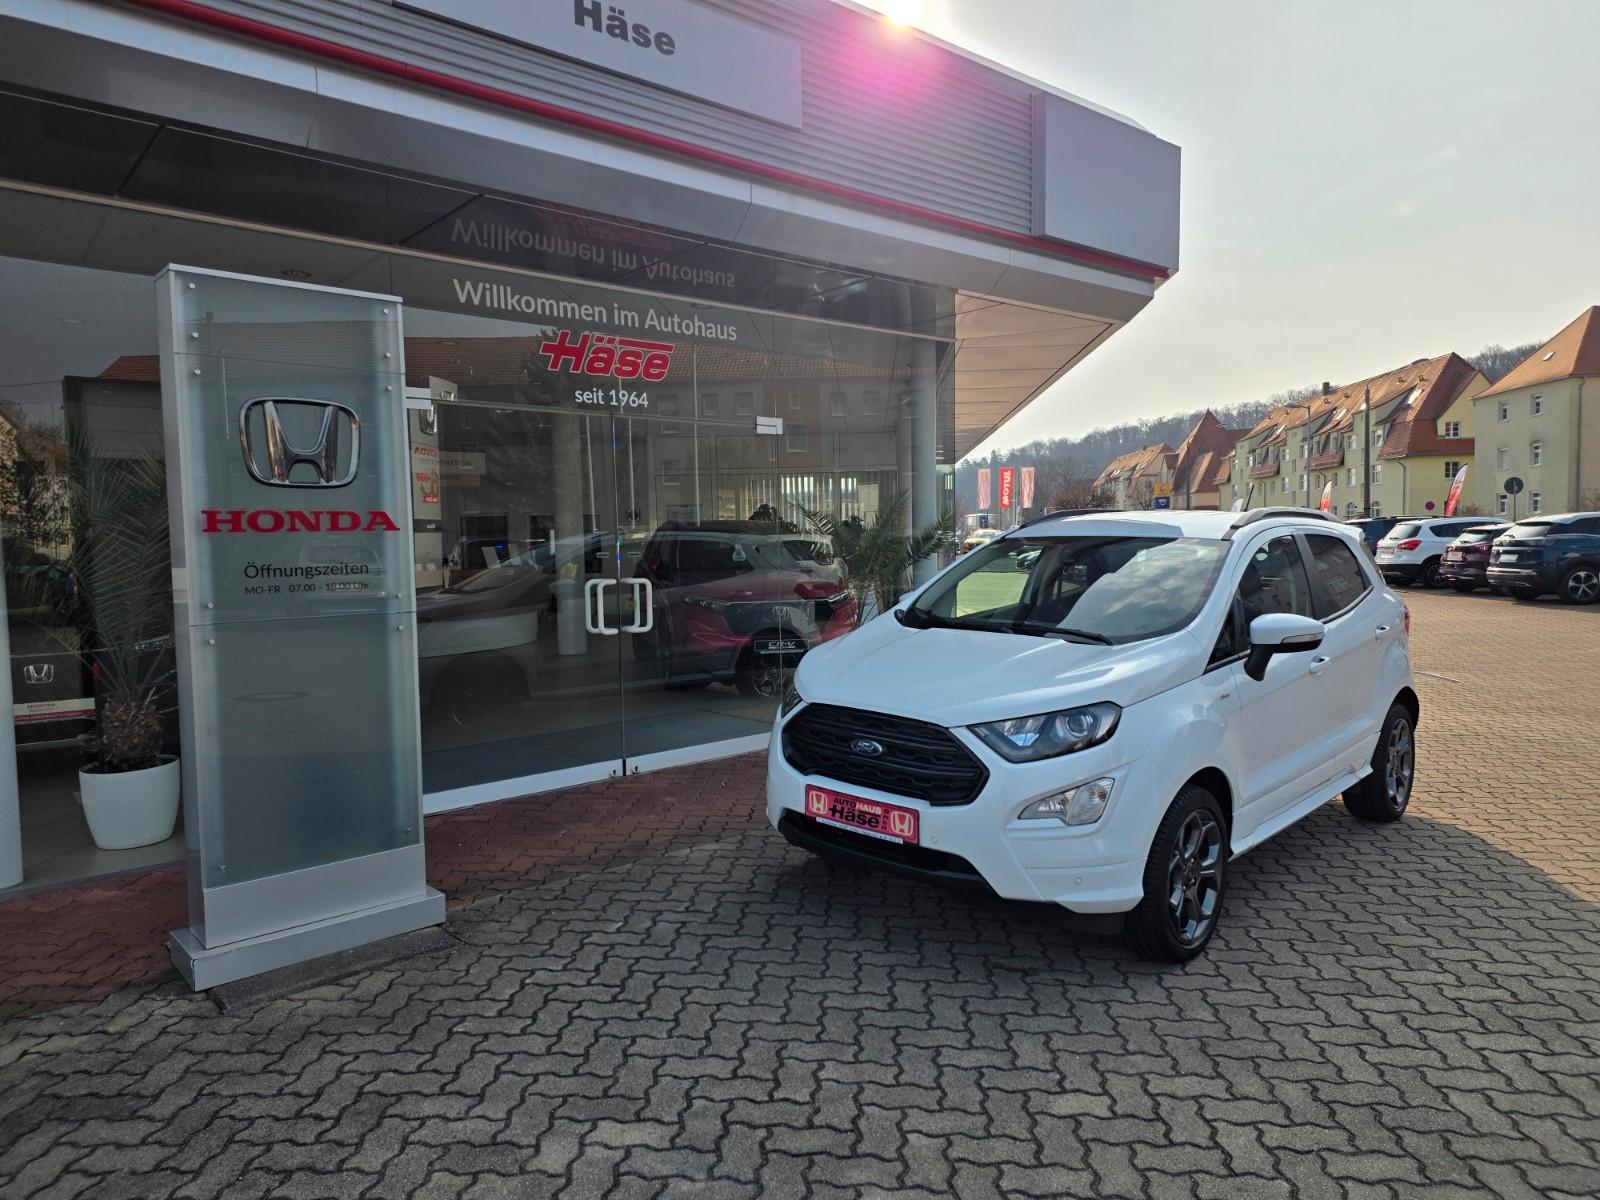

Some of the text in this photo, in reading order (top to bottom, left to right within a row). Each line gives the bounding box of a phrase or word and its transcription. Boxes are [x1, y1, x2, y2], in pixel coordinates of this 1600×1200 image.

[573, 0, 677, 56] Häse
[453, 278, 737, 341] Willkommen im Autohaus
[539, 329, 675, 382] Häse
[574, 387, 649, 408] seit 1964
[1002, 470, 1012, 506] MOTUL
[201, 509, 401, 534] HONDA
[243, 561, 369, 579] Öffnungszeiten
[244, 584, 281, 595] MO-FR
[289, 583, 316, 593] 07.00
[829, 803, 881, 829] Häse
